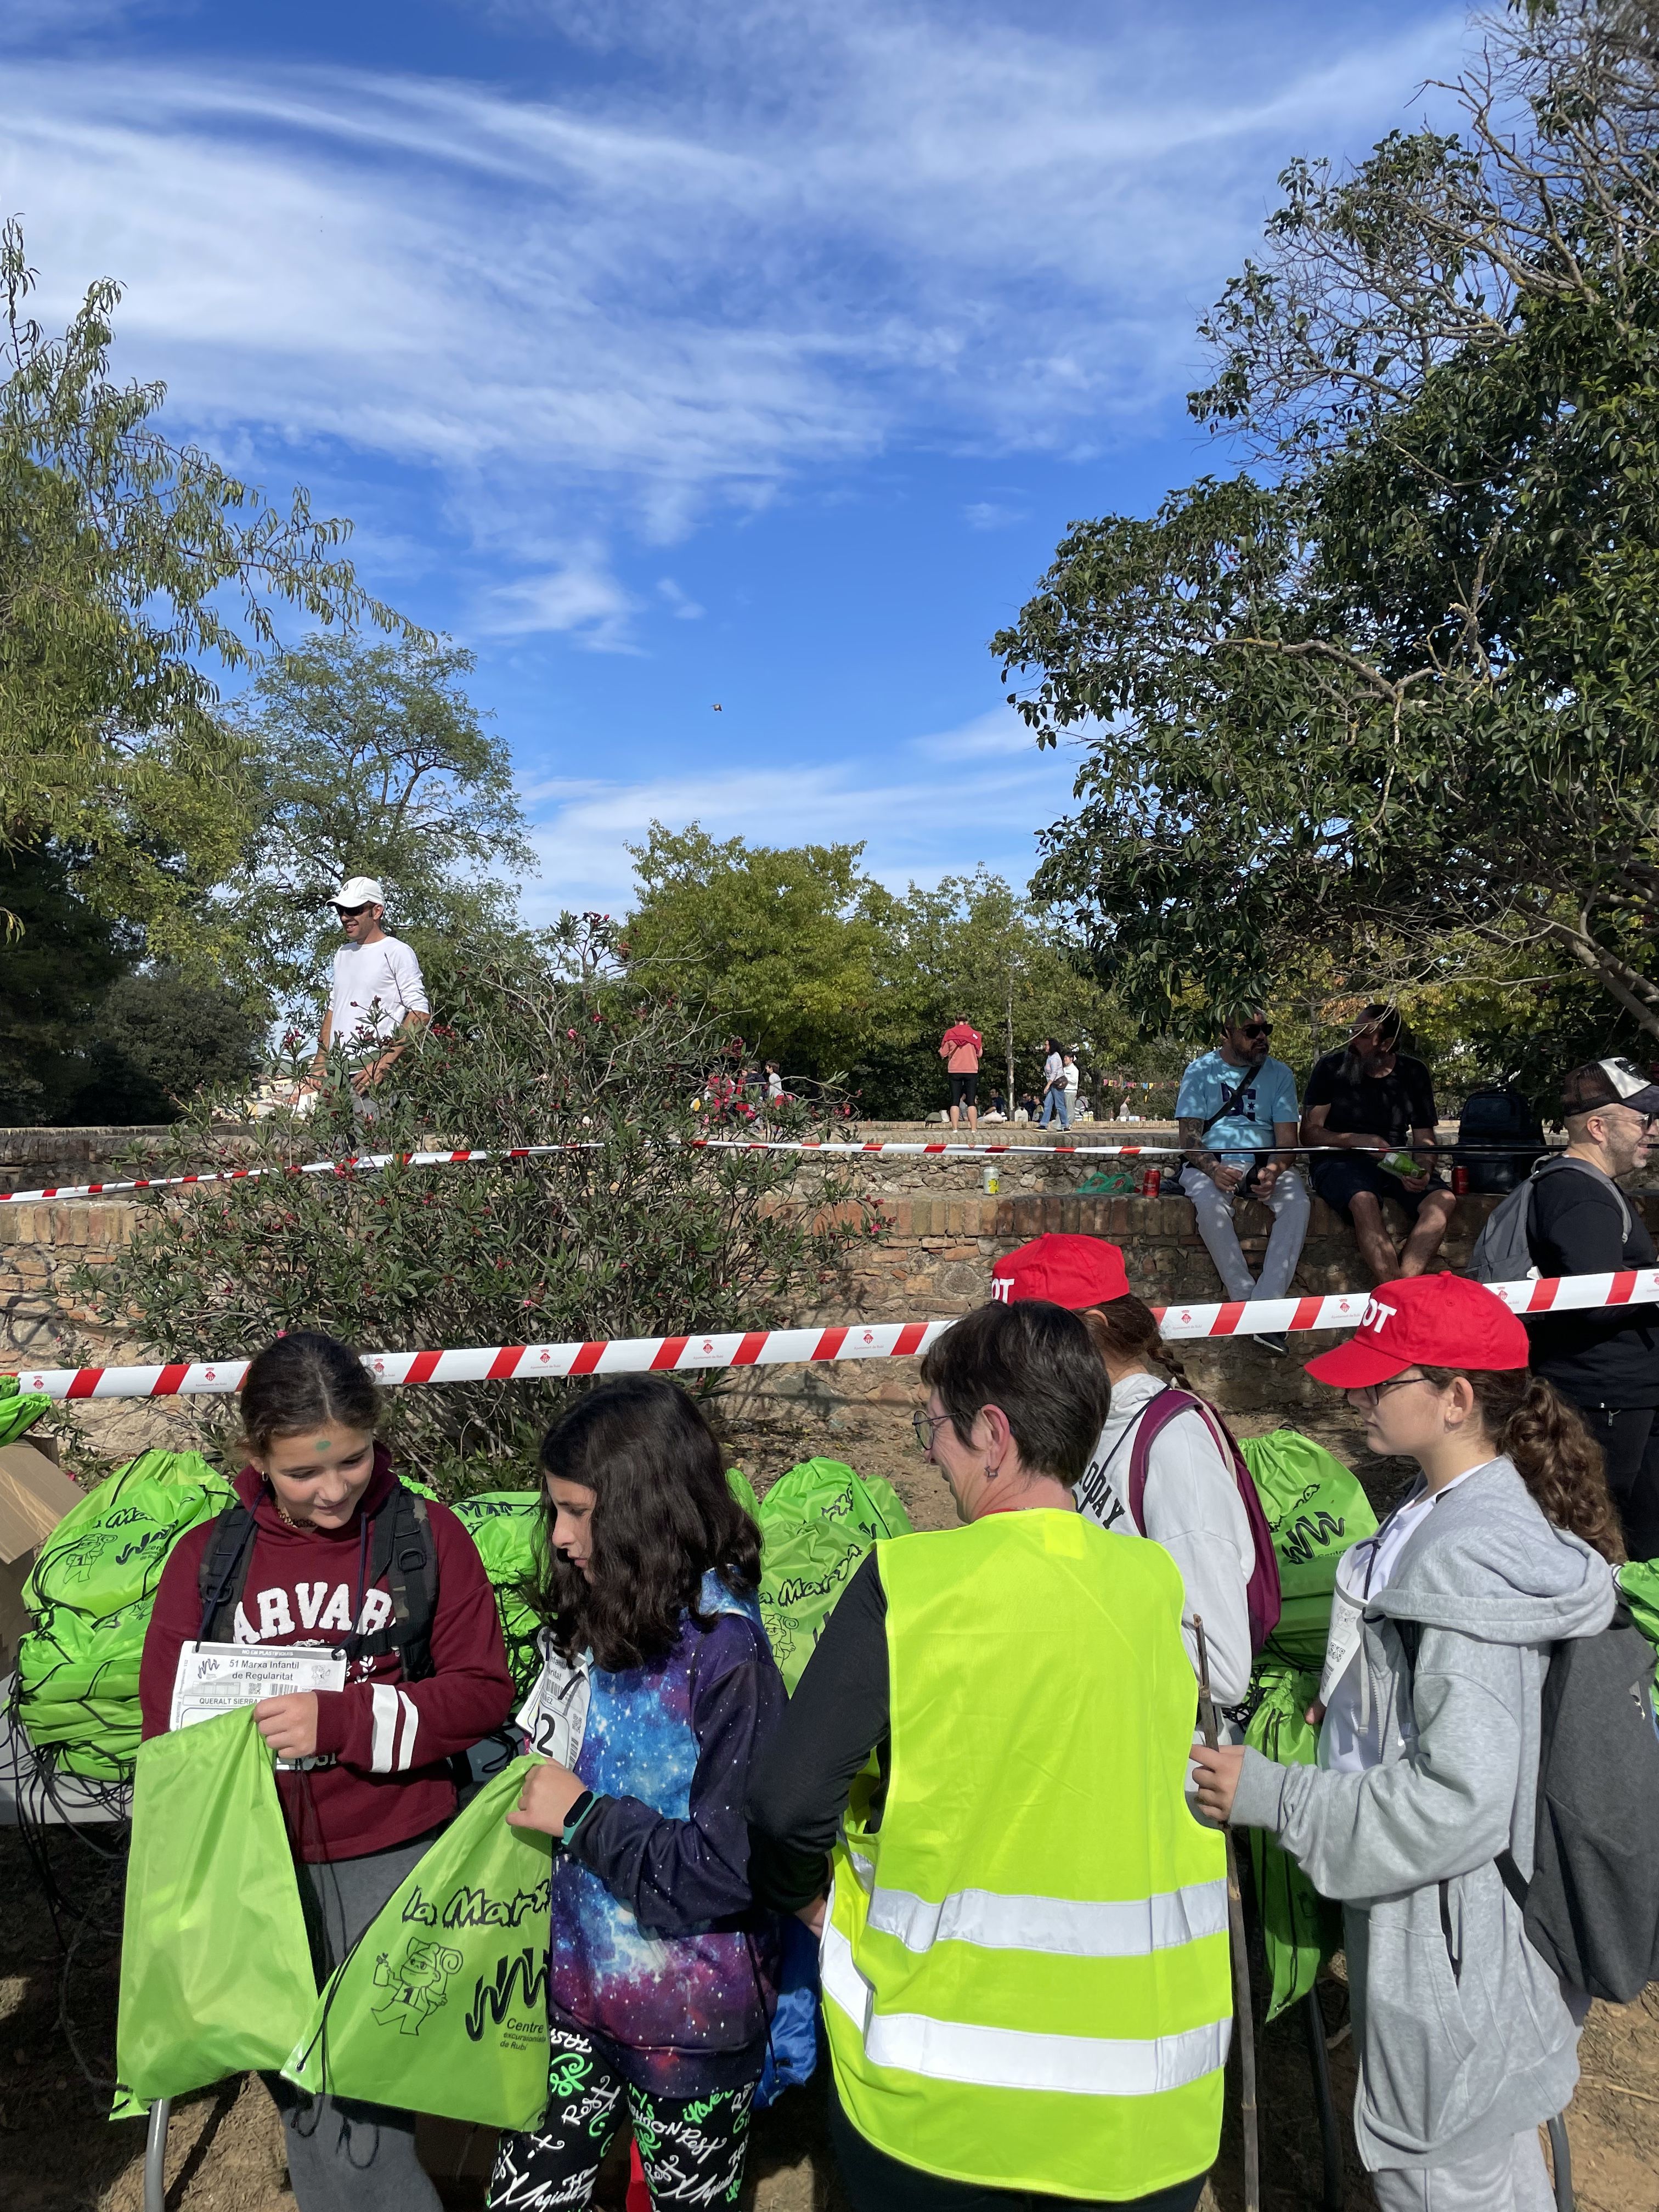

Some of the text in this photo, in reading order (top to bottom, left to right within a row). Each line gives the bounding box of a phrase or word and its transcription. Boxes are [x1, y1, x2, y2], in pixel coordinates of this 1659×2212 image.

[233, 1582, 396, 1644] ARVAR
[229, 1660, 239, 1668] 51
[241, 1660, 267, 1668] Marxa
[246, 1672, 294, 1681] Regularitat
[507, 2018, 544, 2034] Centre
[511, 2041, 527, 2051] Rubí
